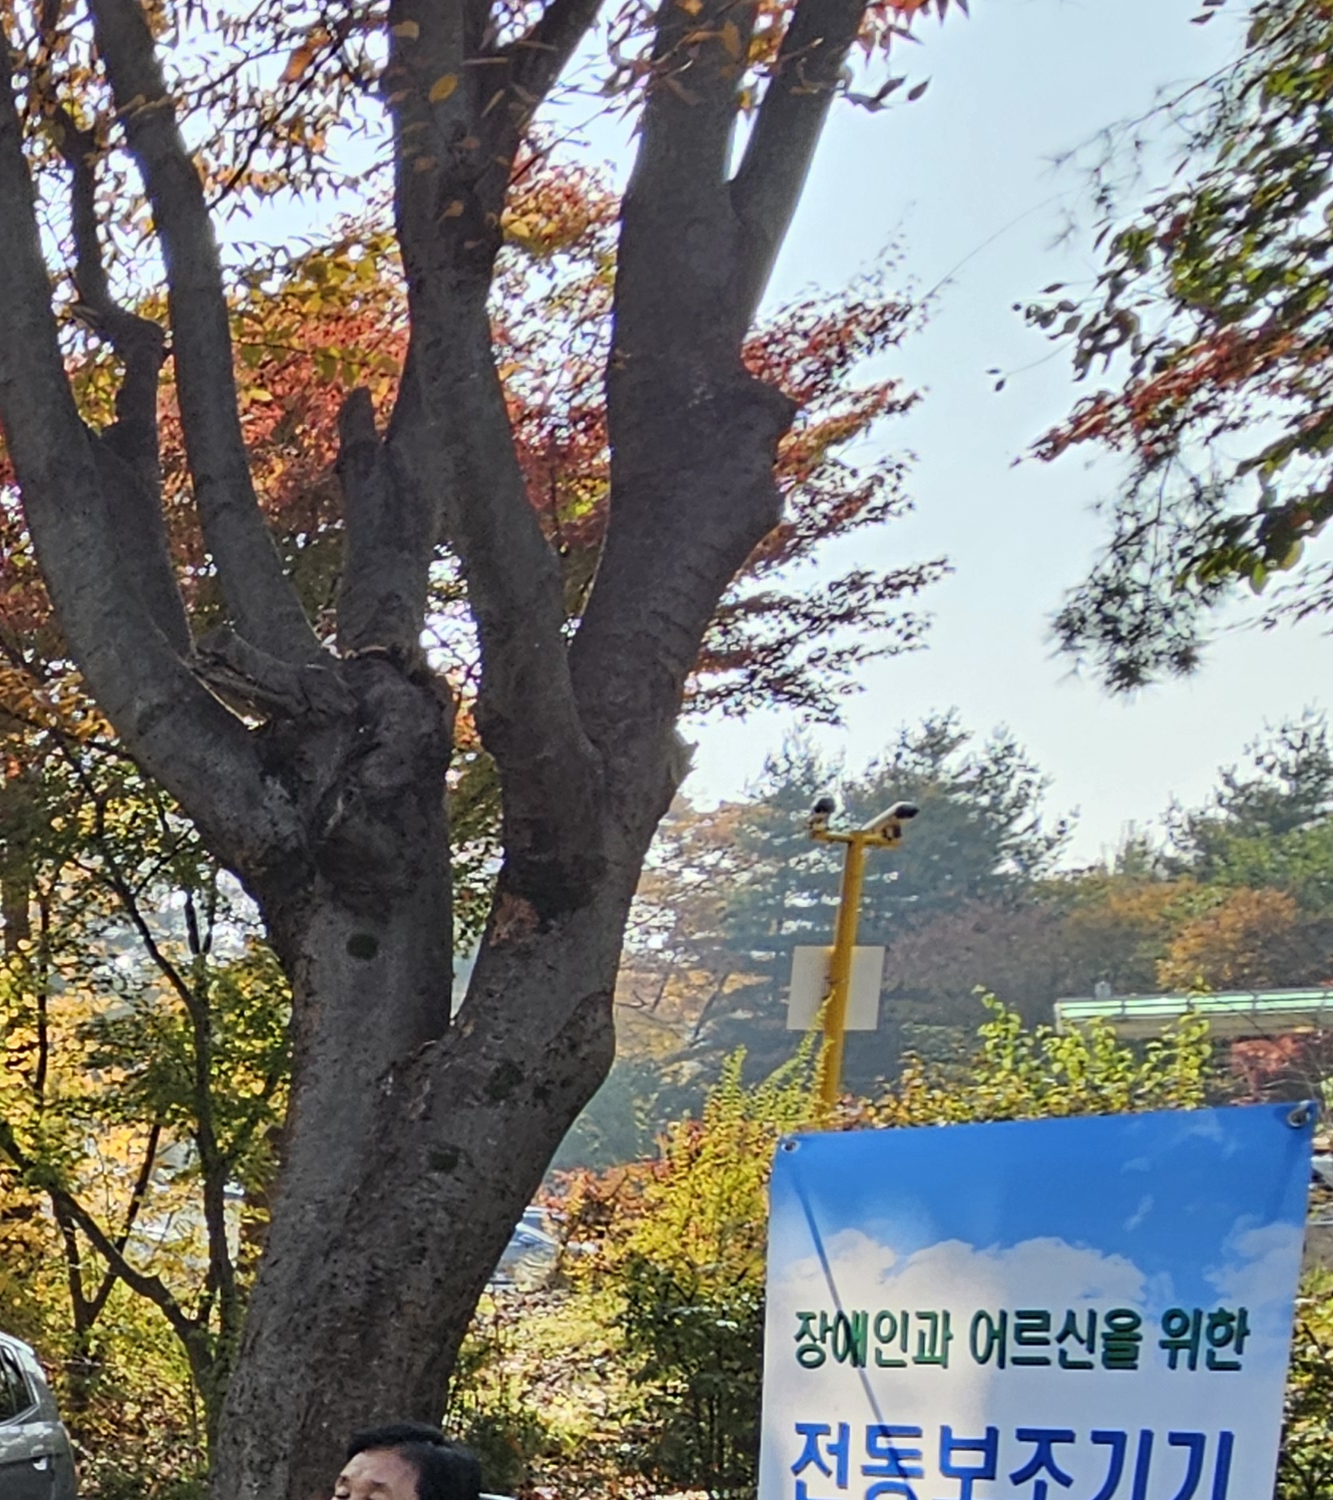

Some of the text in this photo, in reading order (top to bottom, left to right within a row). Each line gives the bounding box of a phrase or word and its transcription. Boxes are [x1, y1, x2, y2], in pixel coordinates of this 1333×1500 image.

[793, 1306, 1251, 1373] 장애인과 어르신을 위한
